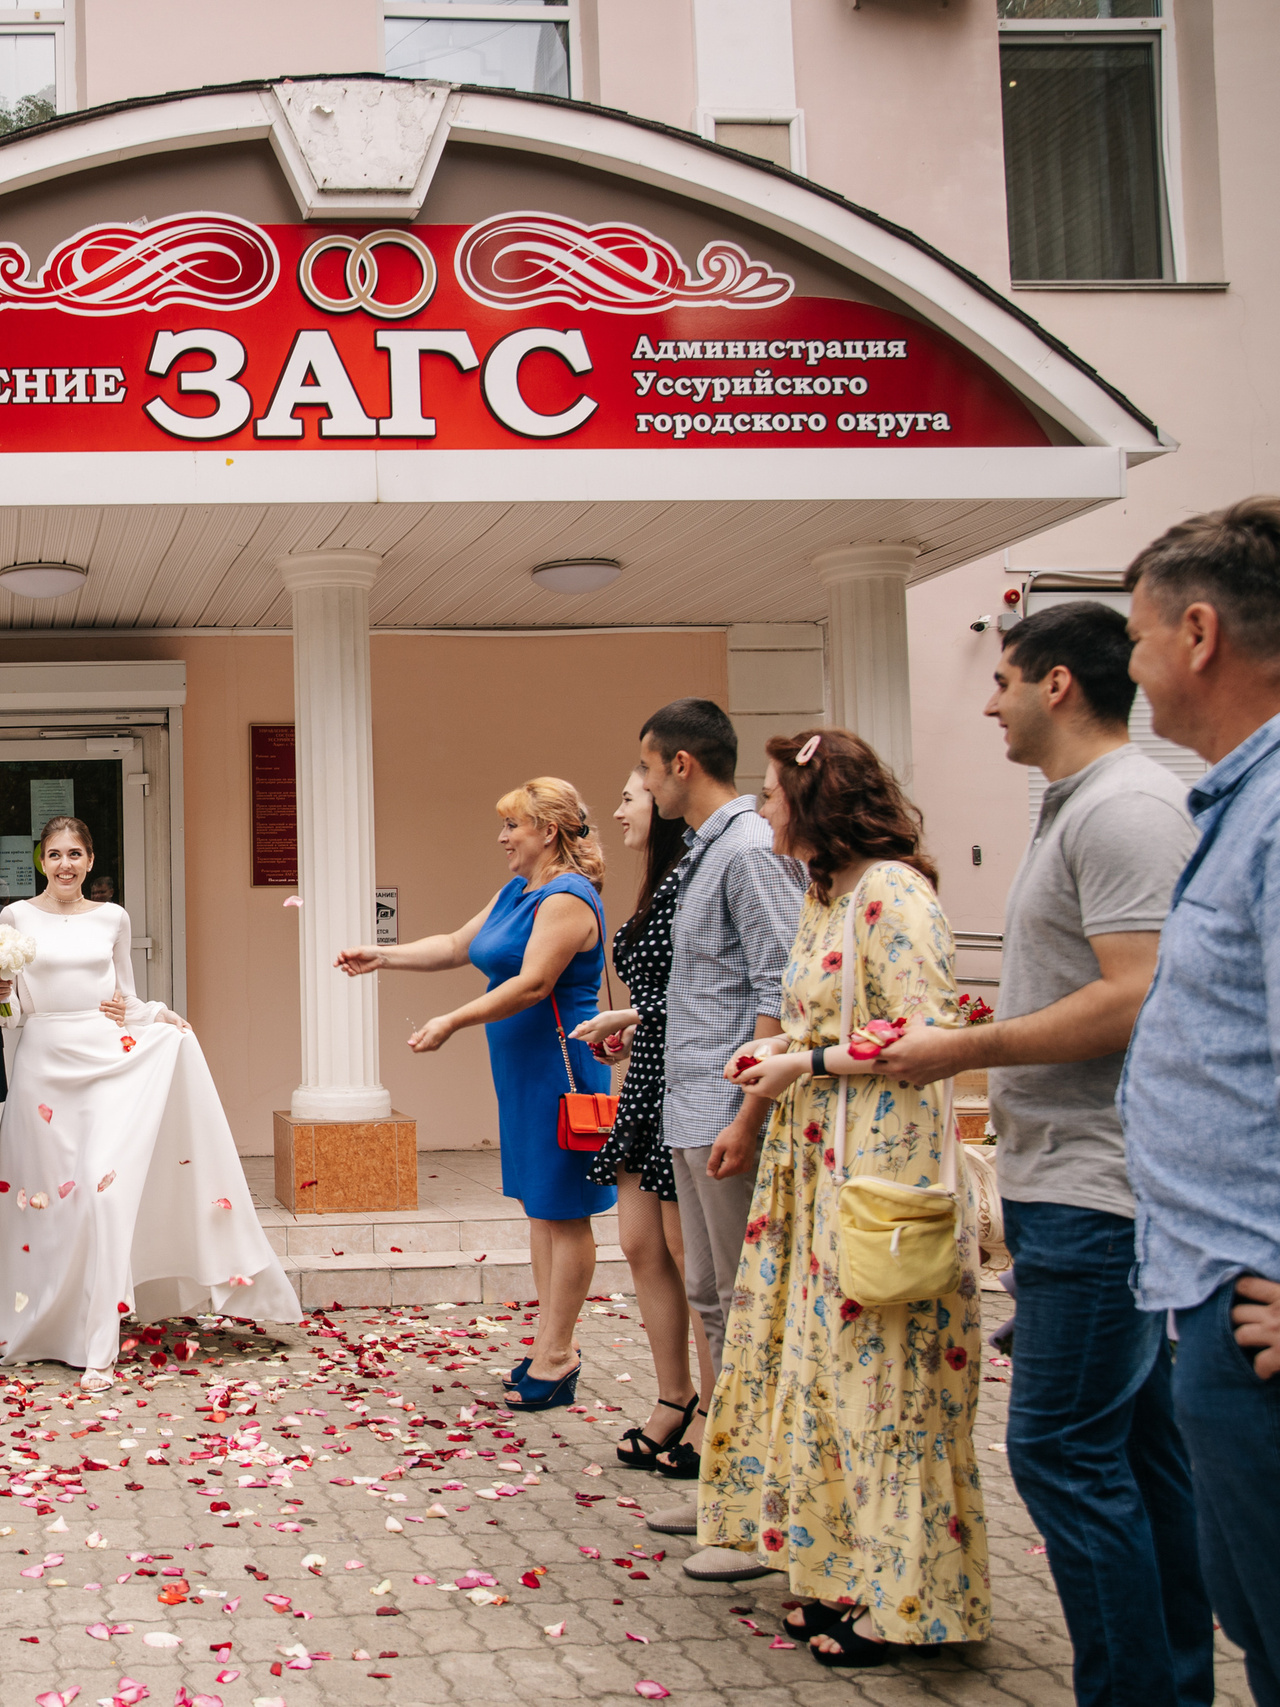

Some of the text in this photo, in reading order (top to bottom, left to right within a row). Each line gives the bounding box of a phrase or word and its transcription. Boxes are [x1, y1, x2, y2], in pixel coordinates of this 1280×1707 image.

[632, 334, 908, 366] Администрация
[142, 327, 599, 439] ЗАГС
[632, 368, 869, 403] Уссурийского
[636, 411, 951, 439] городского округа
